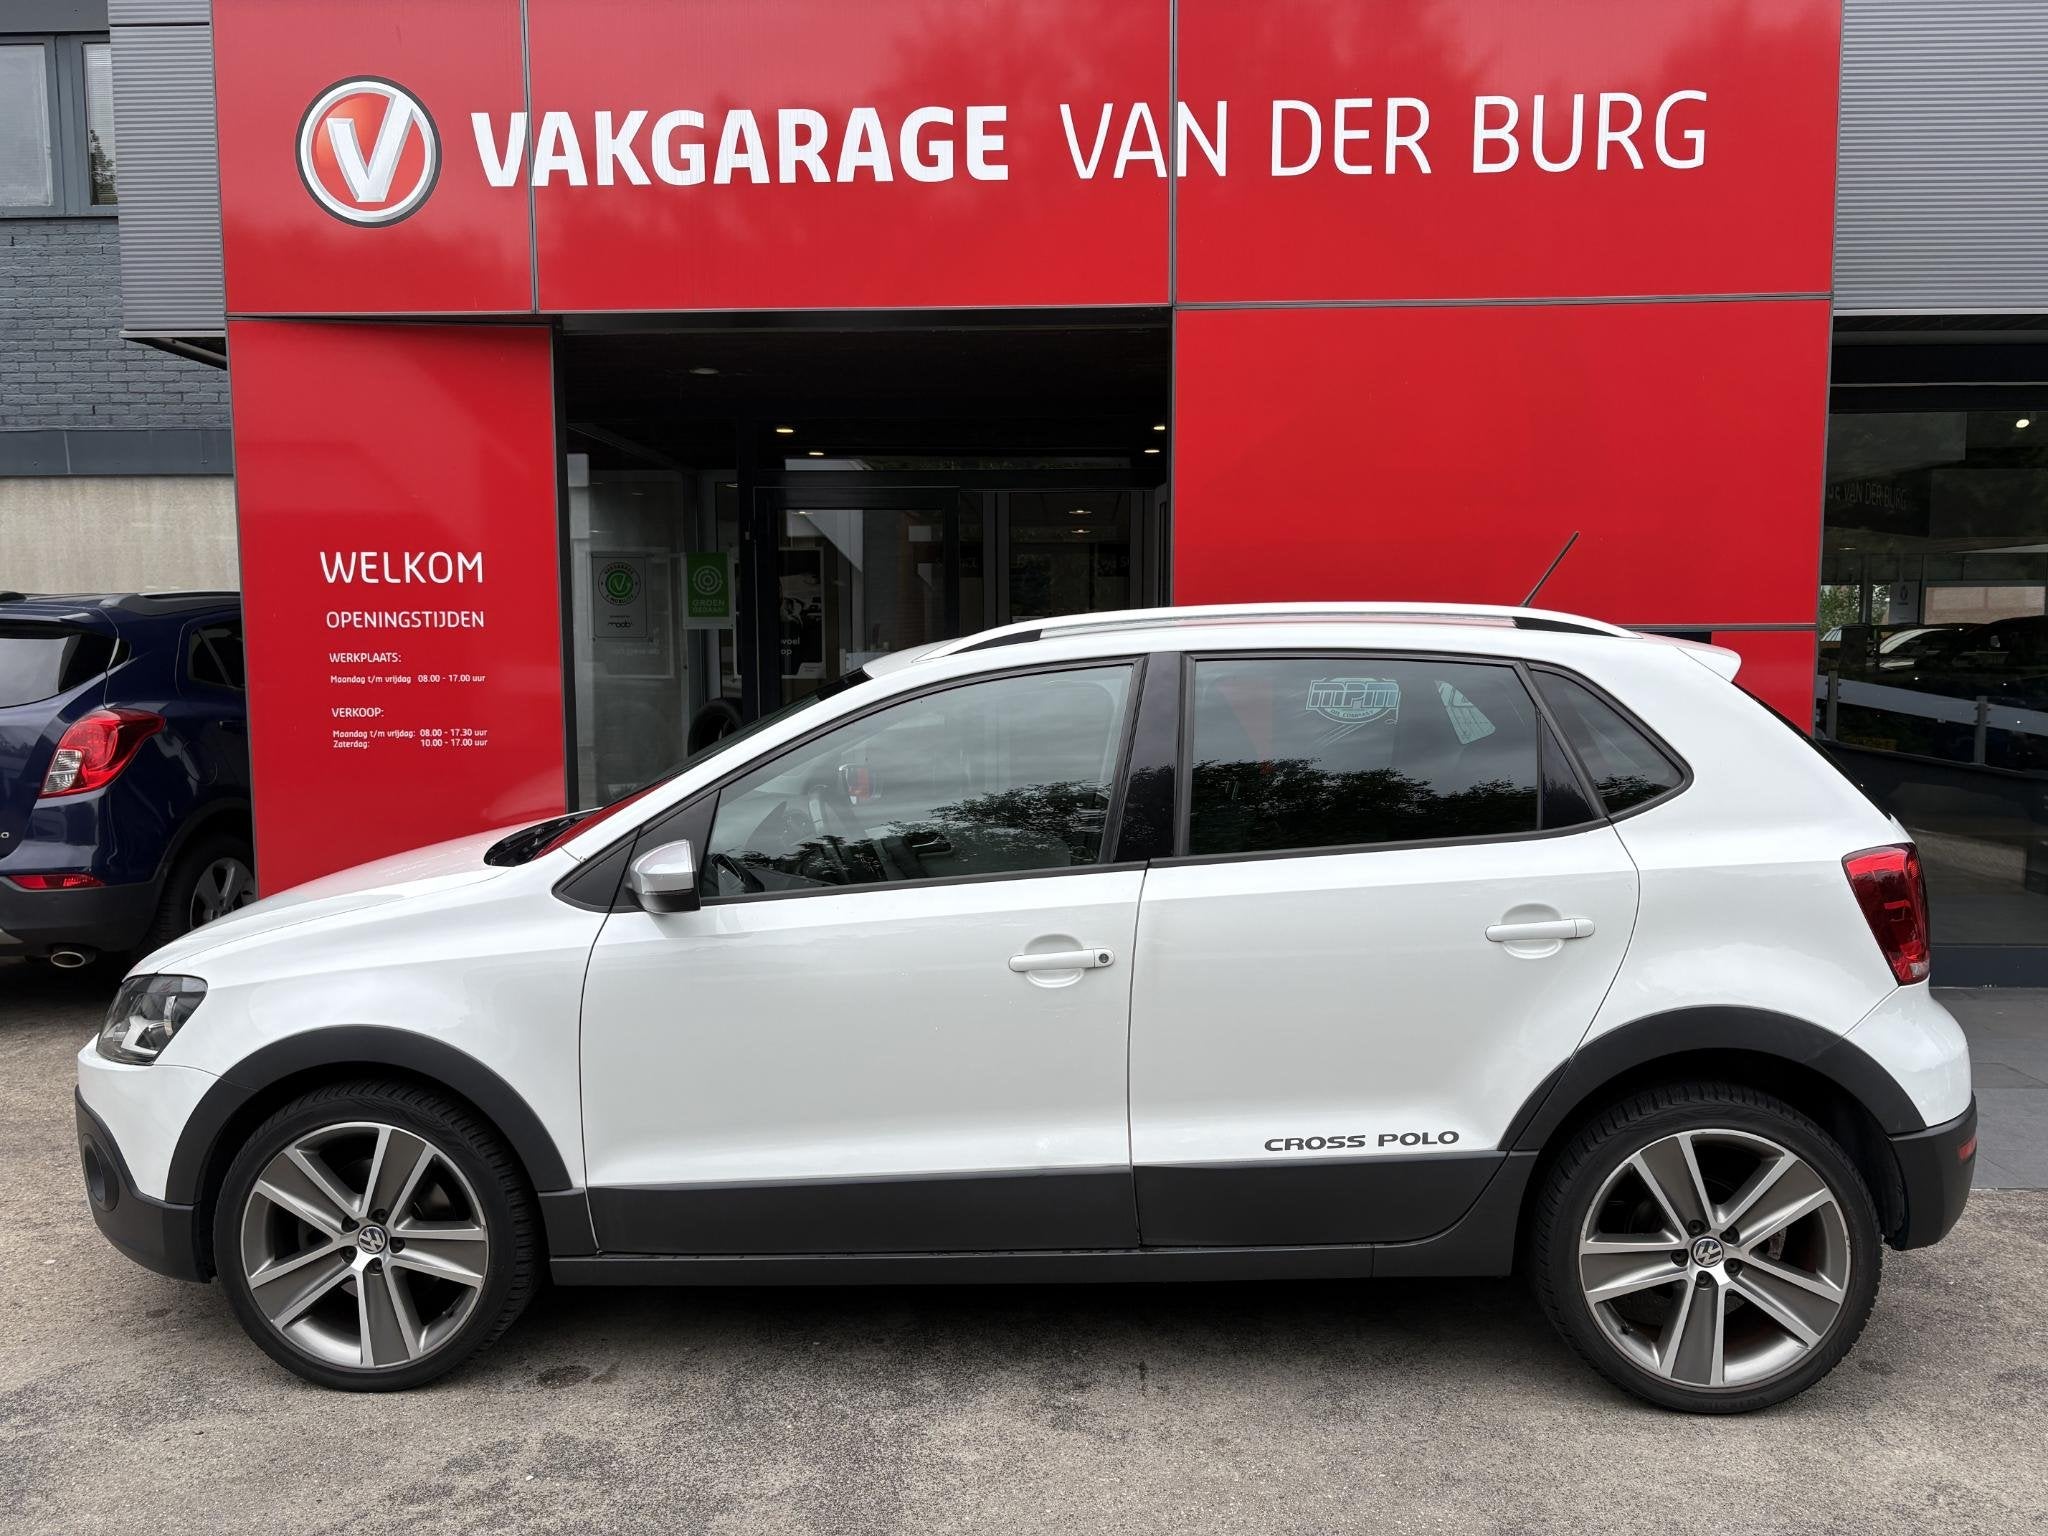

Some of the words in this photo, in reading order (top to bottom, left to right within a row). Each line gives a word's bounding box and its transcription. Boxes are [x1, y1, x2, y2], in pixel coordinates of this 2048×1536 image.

[471, 106, 1009, 187] VAKGARAGE
[1060, 101, 1227, 179] VAN
[1272, 98, 1432, 177] DER
[1474, 90, 1707, 174] BURG
[320, 551, 483, 584] WELKOM
[326, 611, 485, 628] OPENINGSTIJDEN
[329, 652, 402, 663] WERKPLAATS:
[330, 675, 366, 684] Maandag
[368, 675, 383, 684] t/m
[385, 675, 412, 684] vrijdag
[418, 675, 440, 683] 08.00
[448, 674, 471, 683] 17.00
[331, 707, 384, 718] VERKOOP:
[332, 730, 368, 739] Maandag
[370, 729, 386, 739] t/m
[387, 729, 416, 739] vrijdag:
[420, 729, 443, 737] 08.00
[450, 728, 473, 737] 17.30
[333, 739, 370, 749] Zaterdag:
[420, 739, 443, 747] 10.00
[450, 738, 473, 747] 17.00
[1264, 1134, 1366, 1152] CROSS
[1377, 1130, 1460, 1147] POLO
